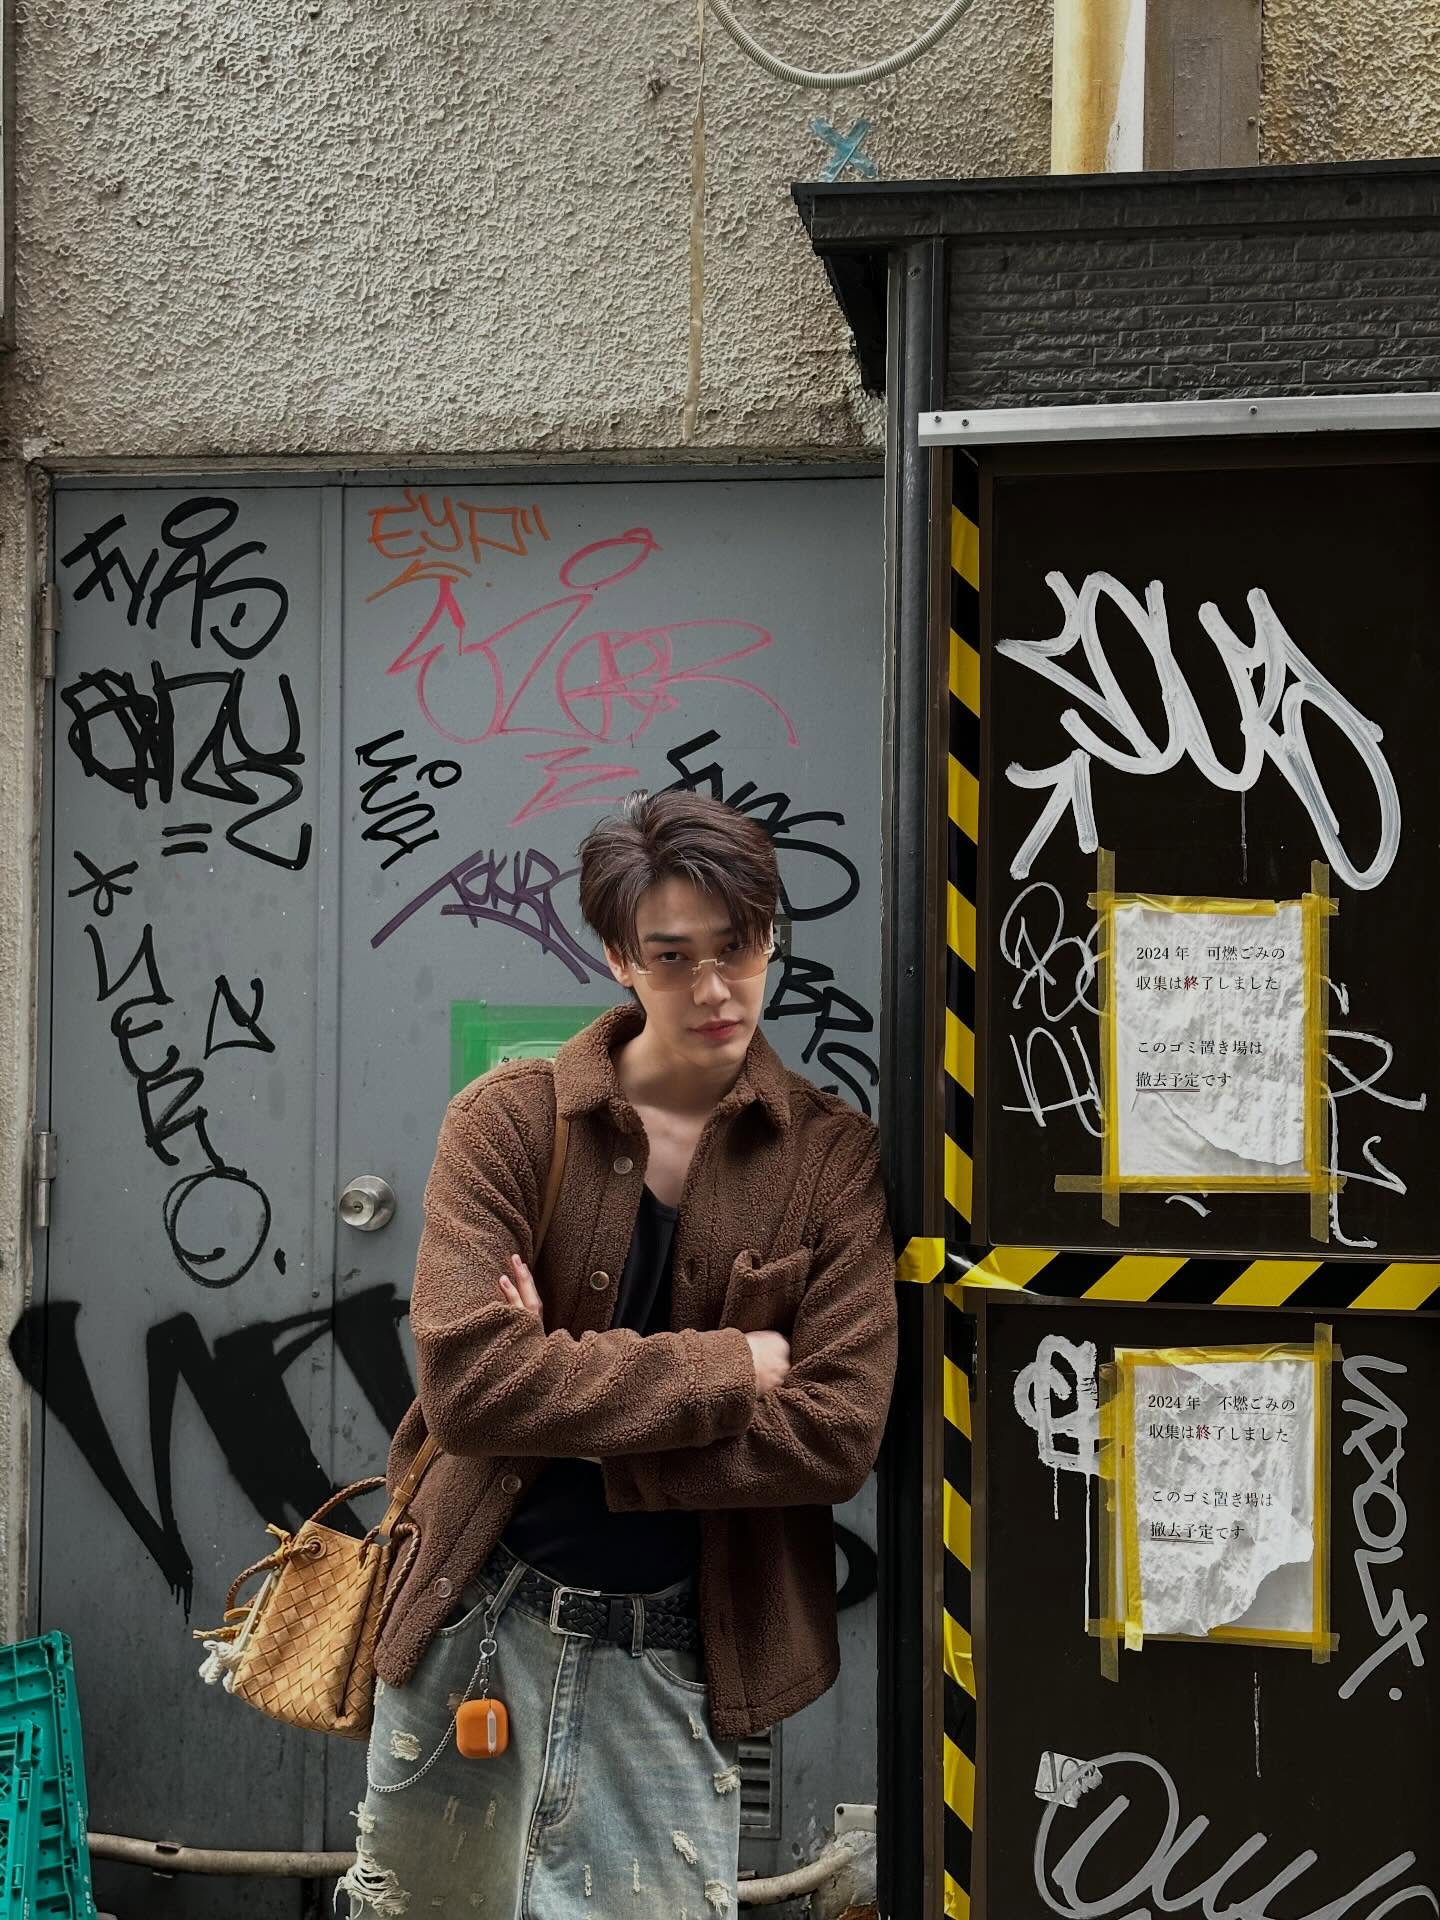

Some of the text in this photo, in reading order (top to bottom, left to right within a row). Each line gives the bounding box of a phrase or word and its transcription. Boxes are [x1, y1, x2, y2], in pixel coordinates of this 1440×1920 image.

[1206, 945, 1286, 961] 可燃ごみの
[1136, 975, 1281, 991] 収集は終了しました
[1138, 1040, 1264, 1055] このゴミ置き場は
[1136, 1072, 1232, 1088] 撤去予定です
[1216, 1395, 1296, 1411] 不燃ごみの
[1149, 1423, 1289, 1443] 収集は終了しました
[1152, 1488, 1274, 1508] このゴミ置き場は
[1151, 1521, 1245, 1540] 撤去予定です
